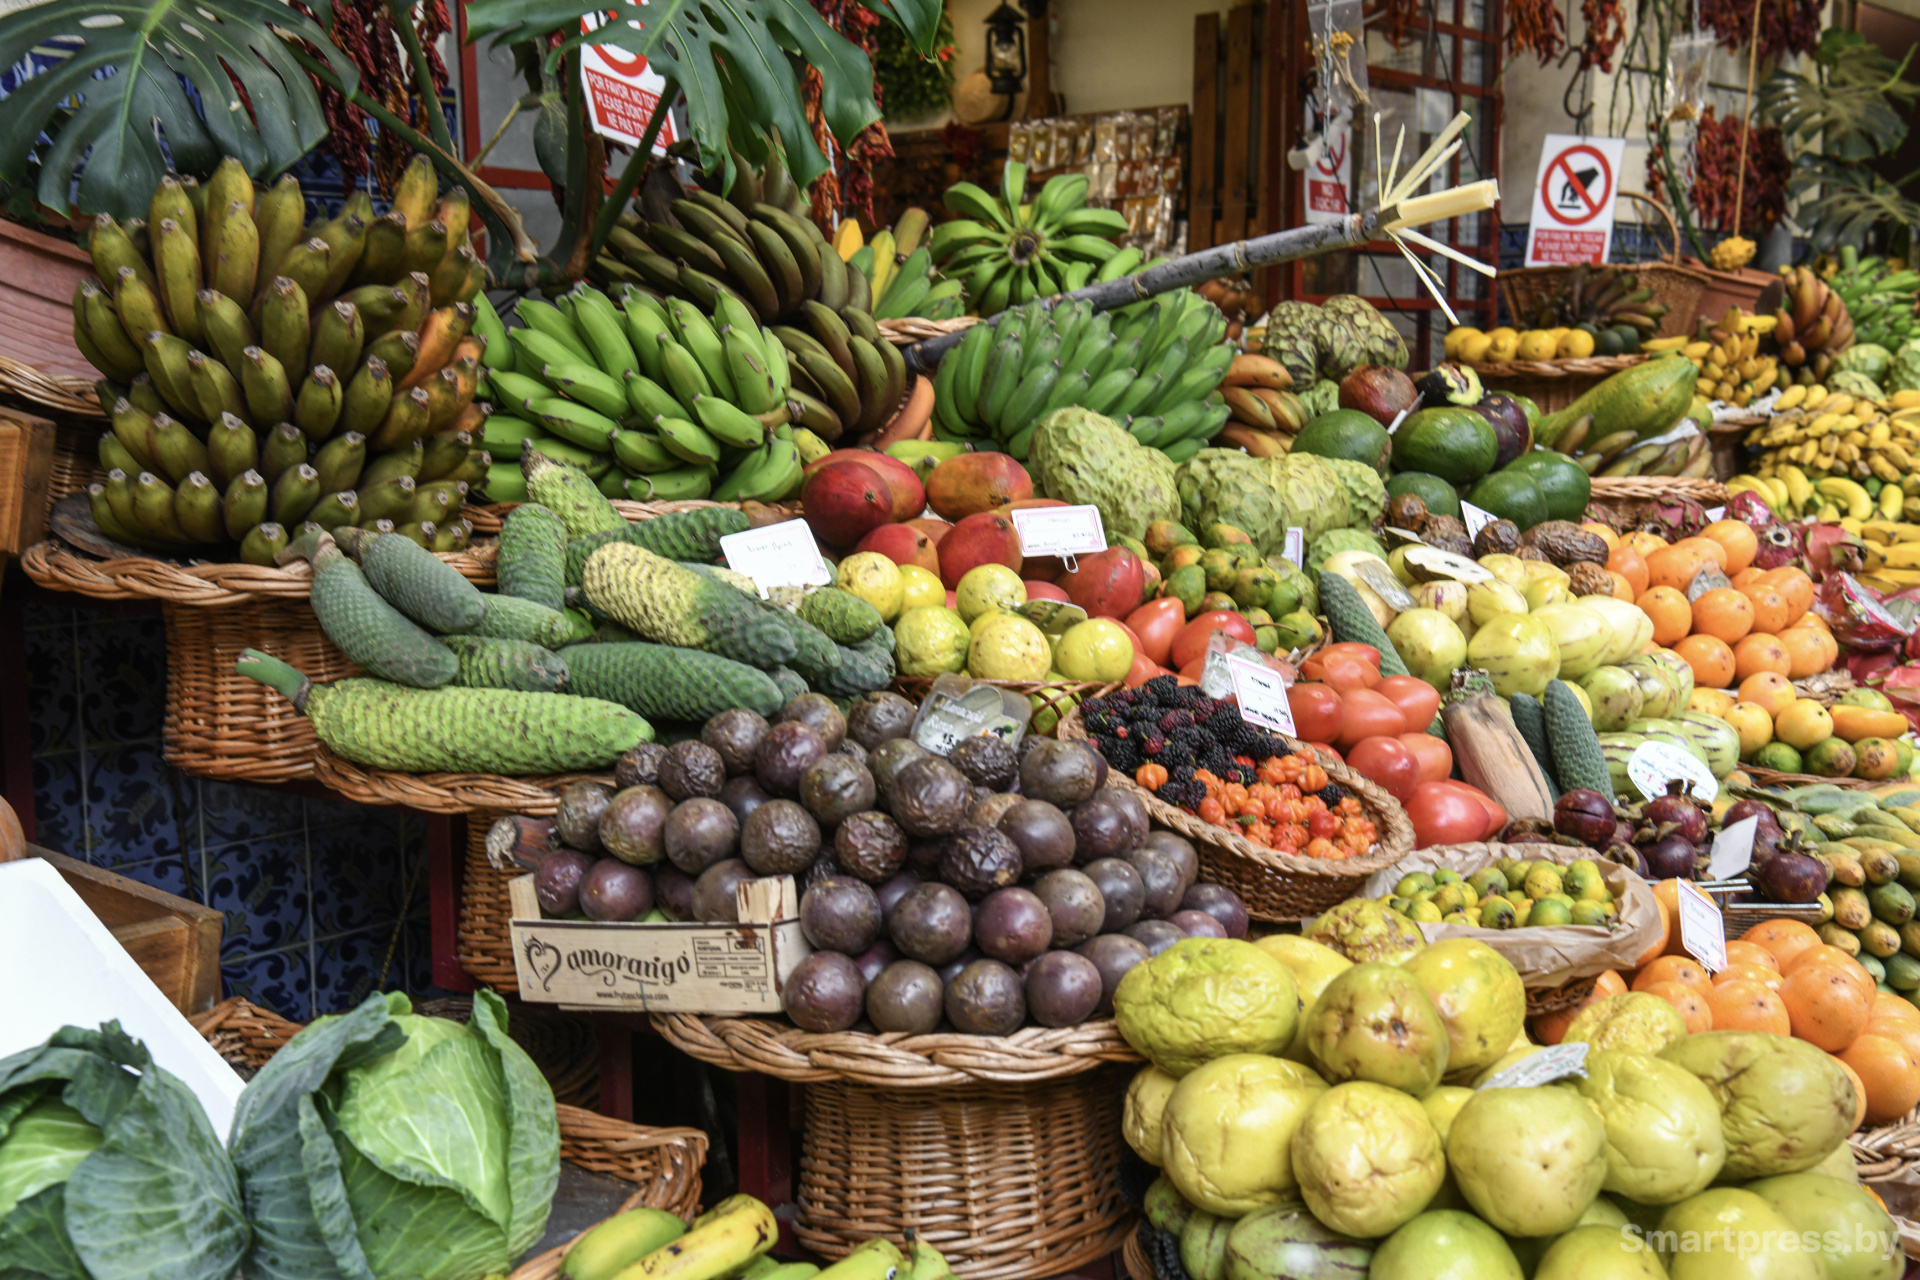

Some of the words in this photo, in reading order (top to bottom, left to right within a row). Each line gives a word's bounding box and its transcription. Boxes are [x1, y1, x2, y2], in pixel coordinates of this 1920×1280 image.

[587, 70, 606, 92] POR
[629, 87, 643, 107] NO
[594, 89, 626, 116] PLEASE
[606, 110, 619, 130] NE
[617, 114, 634, 135] PAS
[1321, 183, 1334, 195] NO
